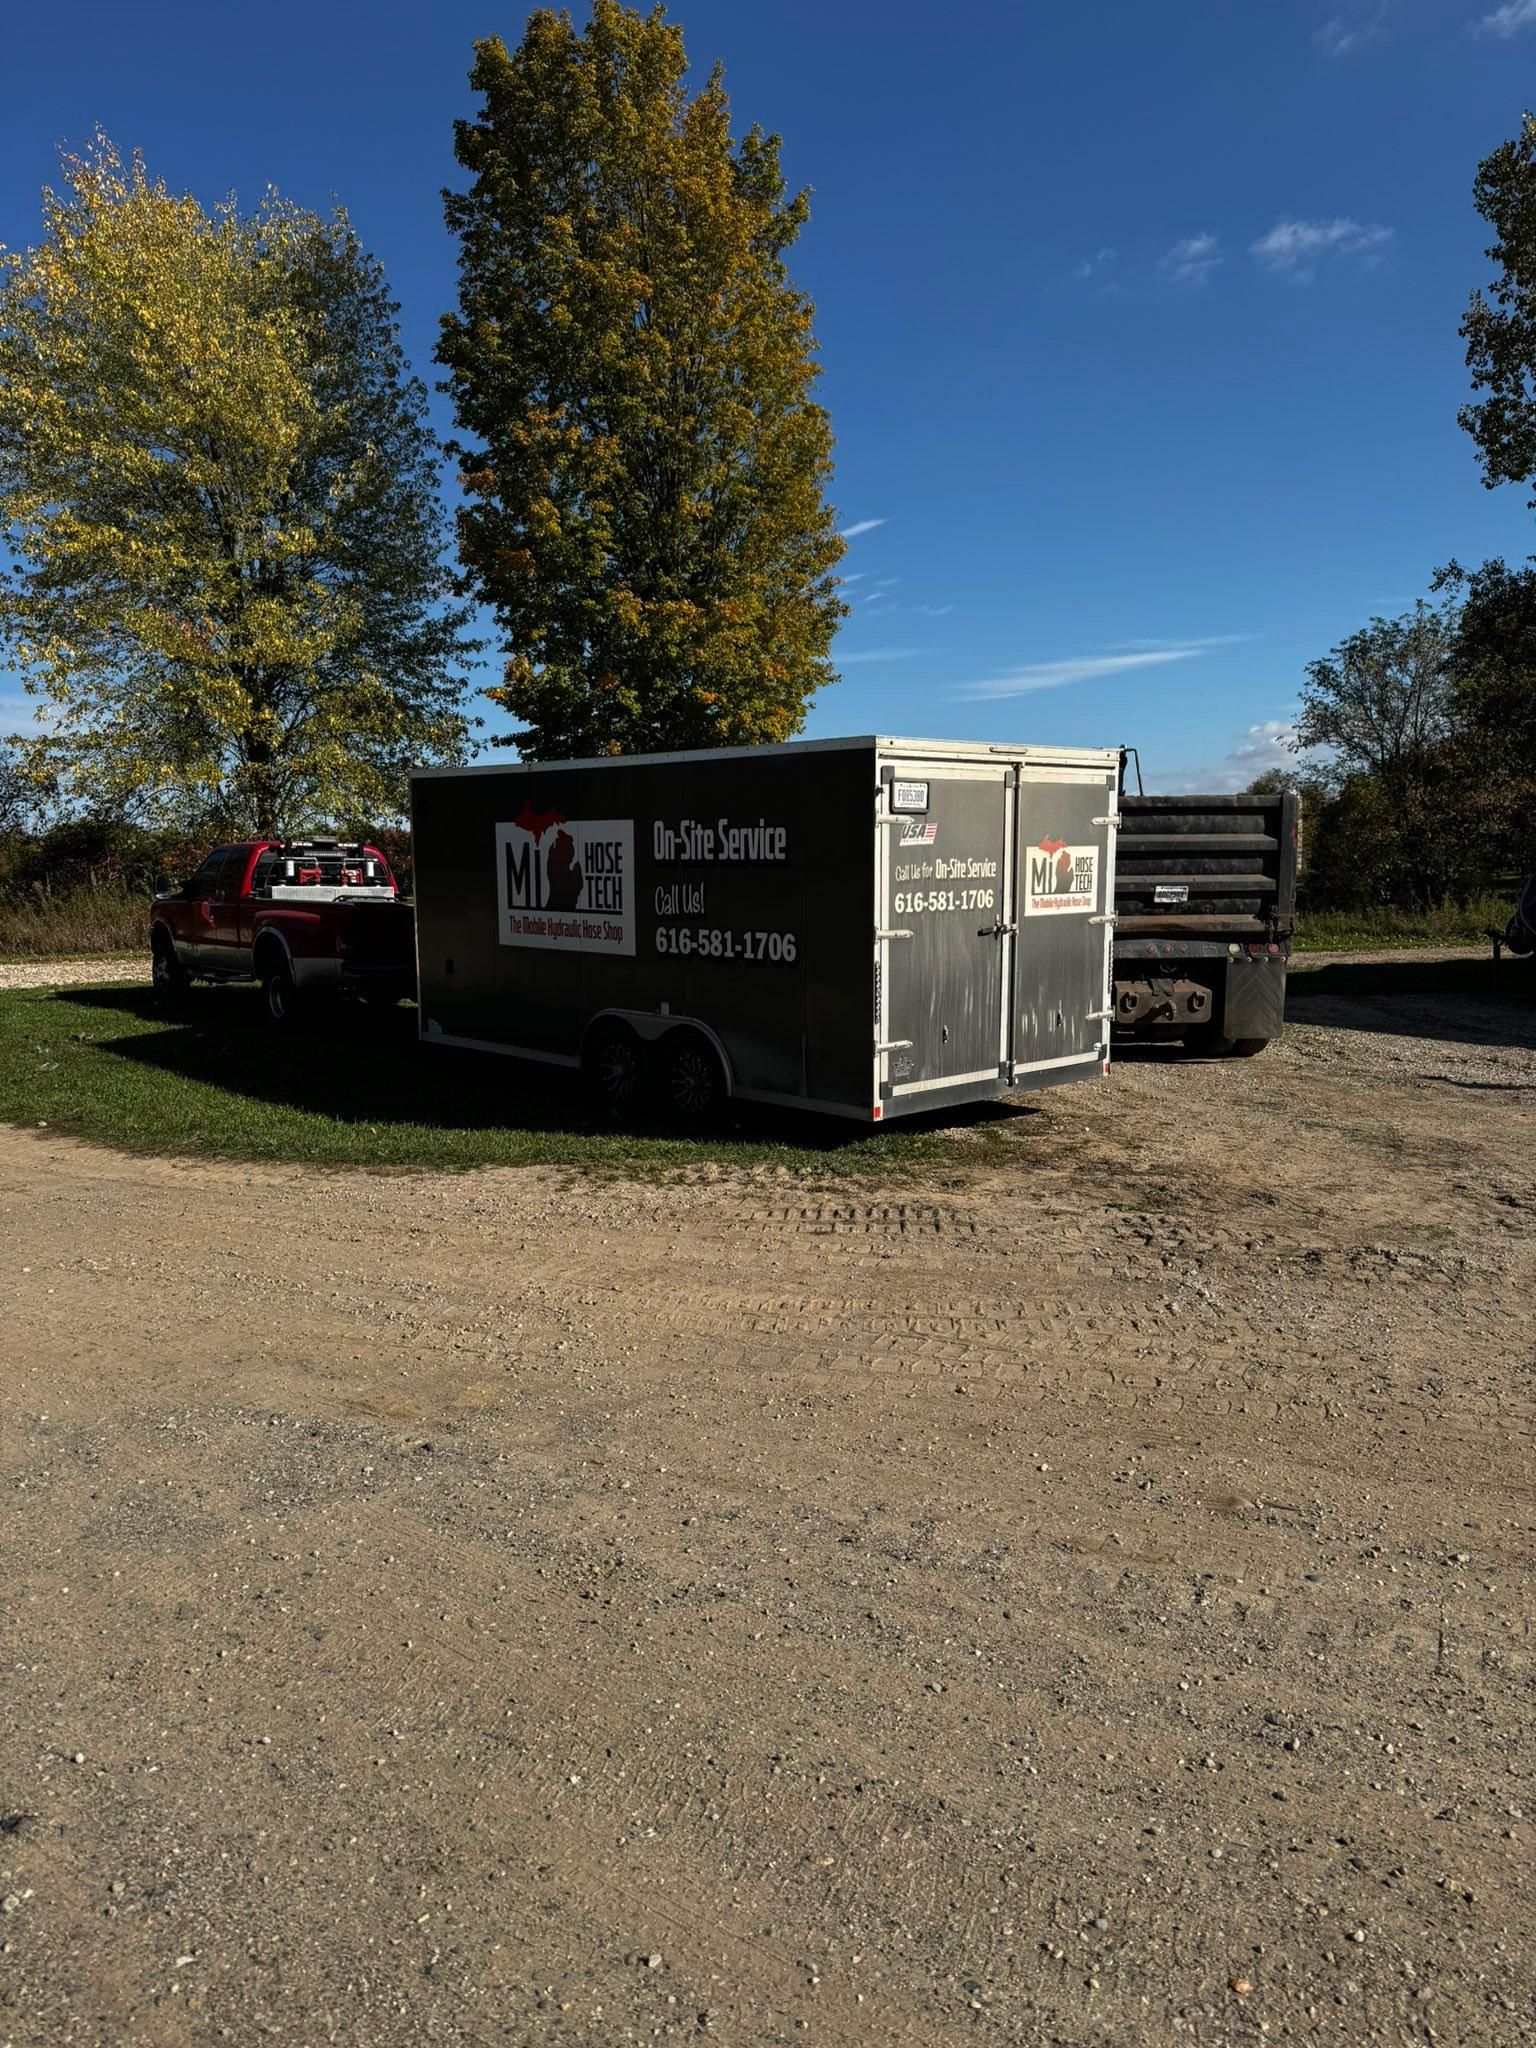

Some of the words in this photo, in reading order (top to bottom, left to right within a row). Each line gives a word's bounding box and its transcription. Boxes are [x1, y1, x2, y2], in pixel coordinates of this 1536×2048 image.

[654, 819, 714, 860] On-Site
[718, 818, 787, 860] Service
[902, 824, 927, 839] USA
[585, 842, 623, 874] HOSE
[895, 864, 910, 881] Call
[911, 864, 921, 880] Us
[922, 862, 933, 878] for
[935, 858, 966, 879] On-Site
[967, 857, 997, 878] Service
[1075, 856, 1094, 873] HOSE
[585, 876, 623, 909] TECH
[1075, 873, 1093, 891] TECH
[655, 883, 679, 915] Call
[682, 881, 704, 914] Us!
[894, 889, 994, 914] 616-581-1706
[1032, 898, 1040, 909] The
[1072, 896, 1082, 907] Hose
[1082, 895, 1092, 908] Shop
[509, 915, 522, 934] The
[523, 916, 546, 936] Mobile
[548, 917, 582, 939] Hydraulic
[582, 920, 602, 939] Hose
[603, 921, 623, 944] Shop
[655, 926, 796, 961] 616-581-1706
